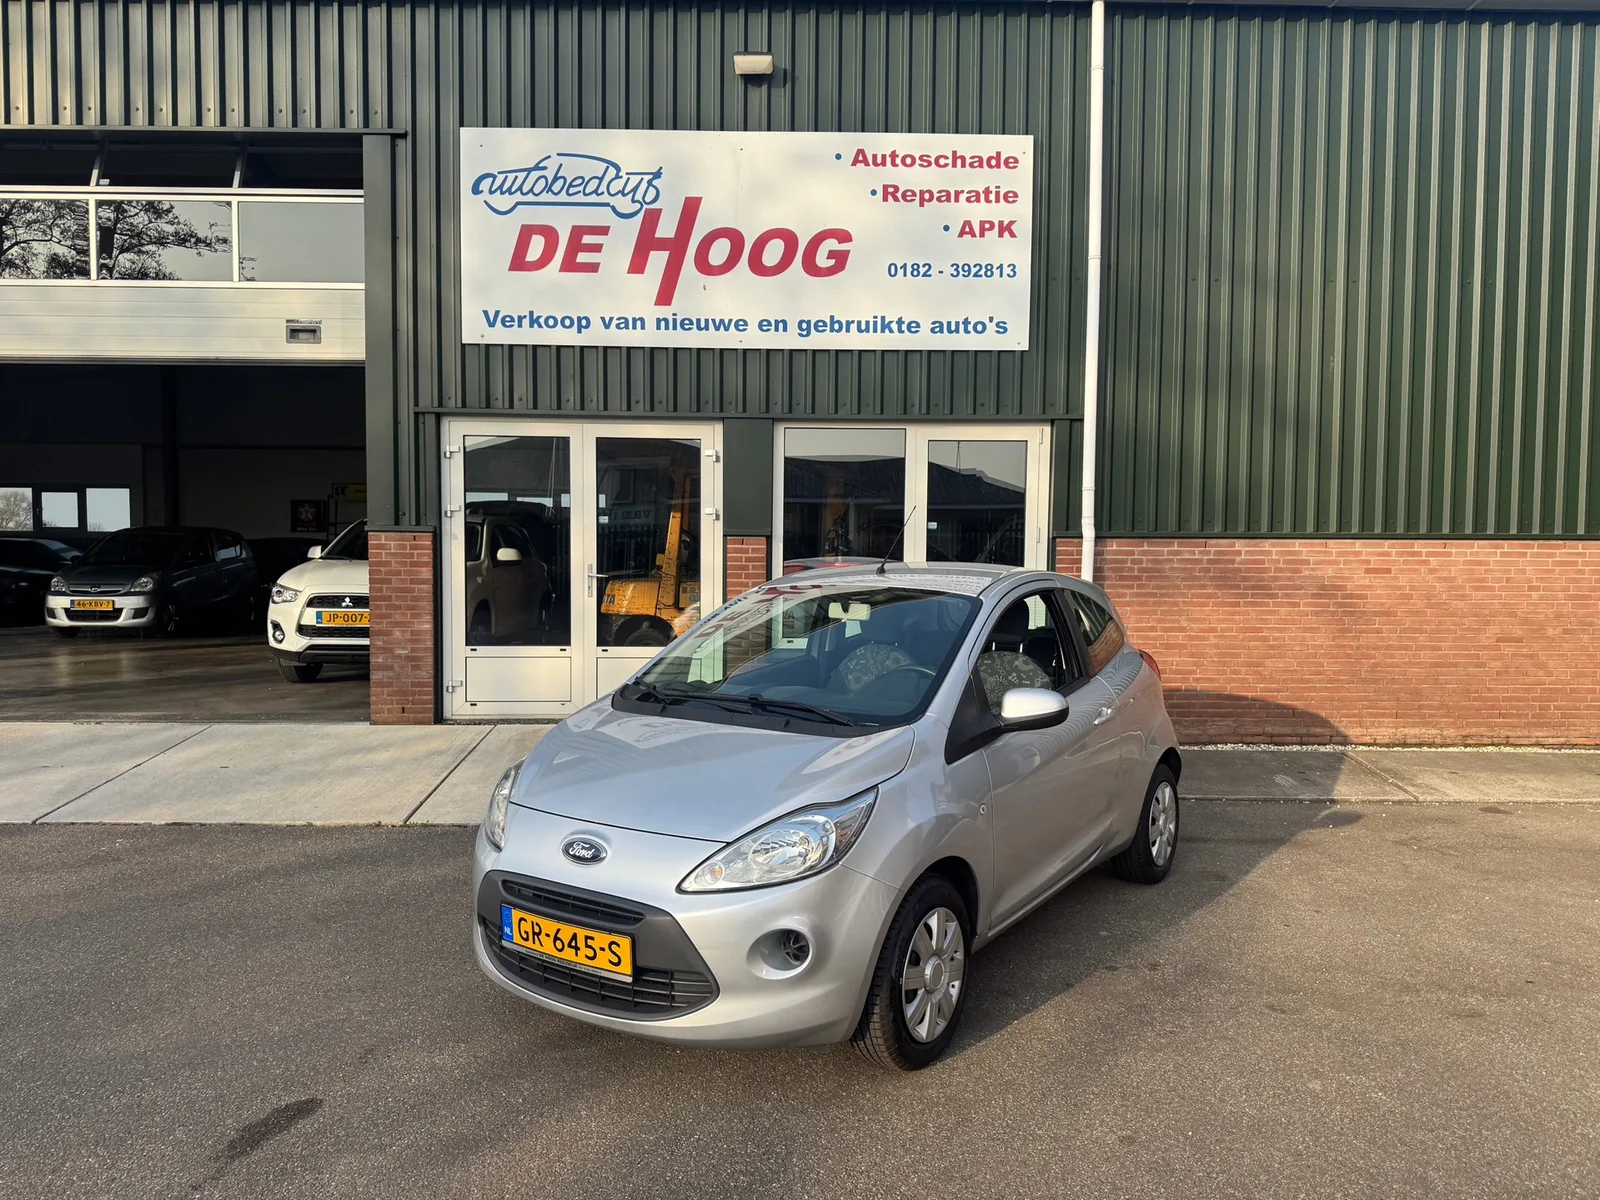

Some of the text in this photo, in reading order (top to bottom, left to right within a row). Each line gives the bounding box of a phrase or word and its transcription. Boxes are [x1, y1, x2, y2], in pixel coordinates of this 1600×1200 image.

[850, 147, 1020, 171] Autoschade
[881, 184, 1020, 208] Reparatie
[957, 219, 1018, 239] APK
[507, 223, 612, 274] DE
[887, 262, 933, 279] 0182
[949, 263, 1018, 280] 392813
[481, 309, 1009, 337] Verkoop van nieuwe en gebruikte auto's
[569, 841, 595, 858] Ford
[504, 916, 622, 967] NL GR-645-S
